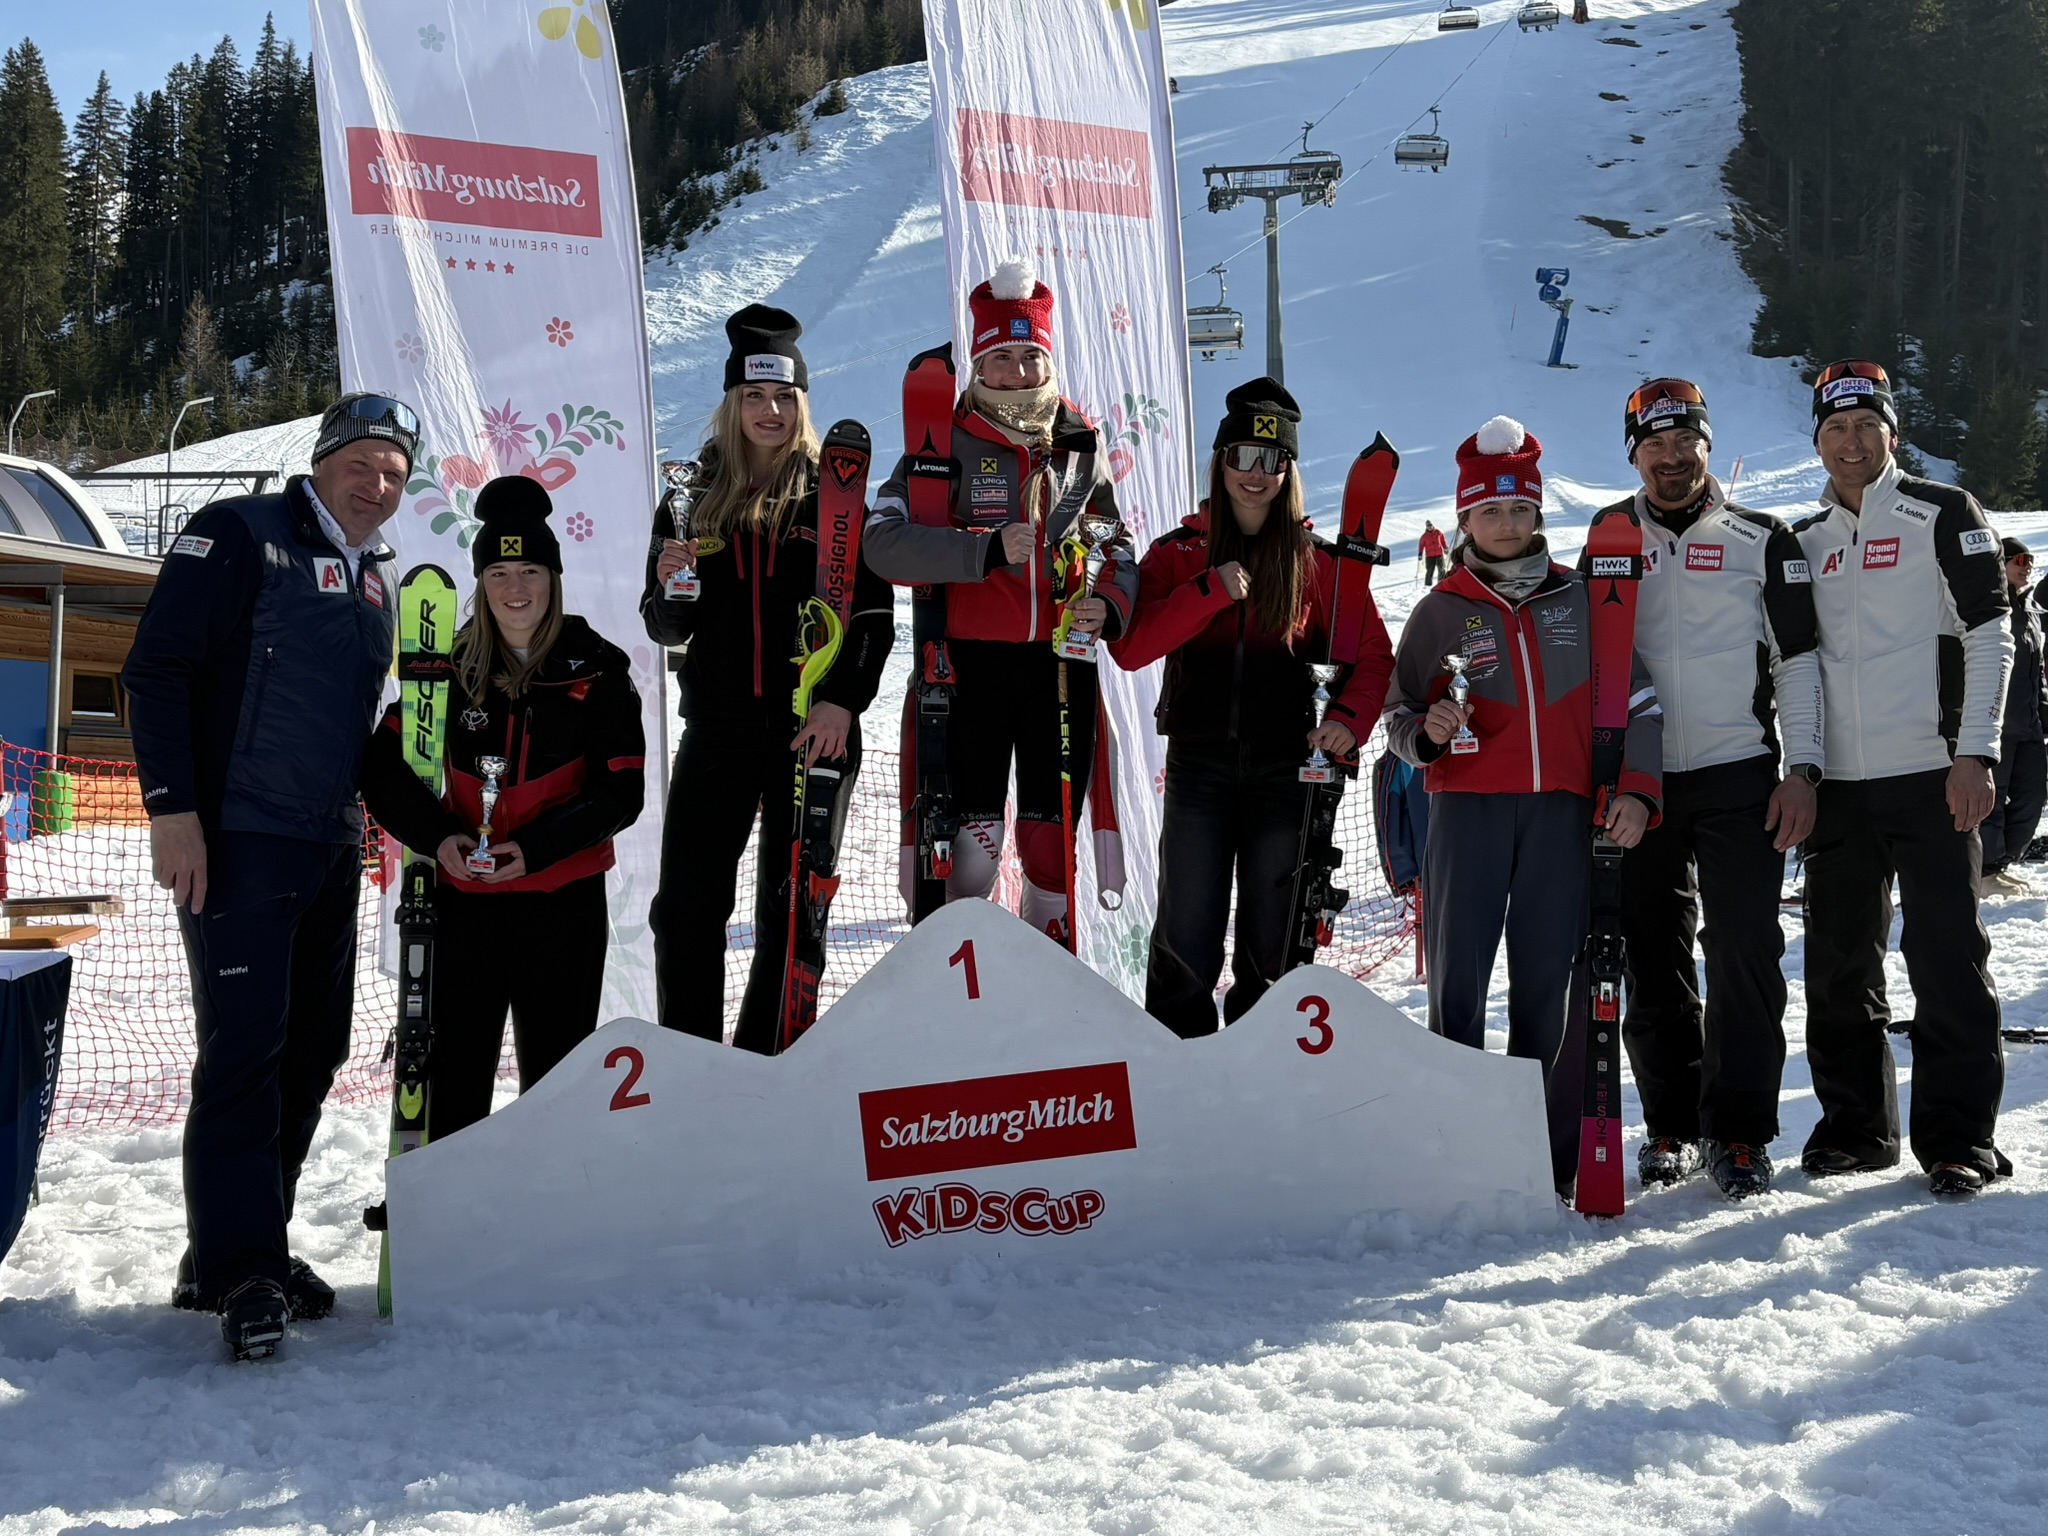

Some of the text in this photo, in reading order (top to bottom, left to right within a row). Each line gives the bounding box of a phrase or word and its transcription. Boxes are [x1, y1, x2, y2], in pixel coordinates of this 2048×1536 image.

[754, 361, 774, 369] vkw
[1841, 379, 1871, 387] INTER
[1841, 385, 1871, 393] SPORT
[1654, 405, 1684, 415] SPORT
[920, 464, 950, 472] ATOMIC
[982, 477, 1007, 485] UNIQA
[1903, 507, 1928, 522] Schöffel
[1730, 523, 1758, 541] Schöffel
[1347, 543, 1377, 557] ATOMIC
[1689, 546, 1721, 557] Kronen
[1866, 543, 1897, 553] Kronen
[829, 510, 850, 613] ROSSIGNOL
[1595, 560, 1629, 569] HWK
[1688, 556, 1720, 568] Zeitung
[1821, 548, 1844, 575] A1
[1865, 553, 1895, 565] Zeitung
[322, 562, 343, 589] A1
[1469, 628, 1493, 638] UNIQA
[416, 598, 437, 762] FISCER
[1059, 710, 1071, 756] LEKI
[1593, 730, 1611, 743] S9
[793, 763, 803, 806] LEKI
[219, 965, 249, 977] Schöffel
[949, 939, 980, 1000] 1
[1296, 995, 1334, 1055] 3
[603, 1045, 651, 1112] 2
[880, 1092, 1114, 1149] SalzburgMilch
